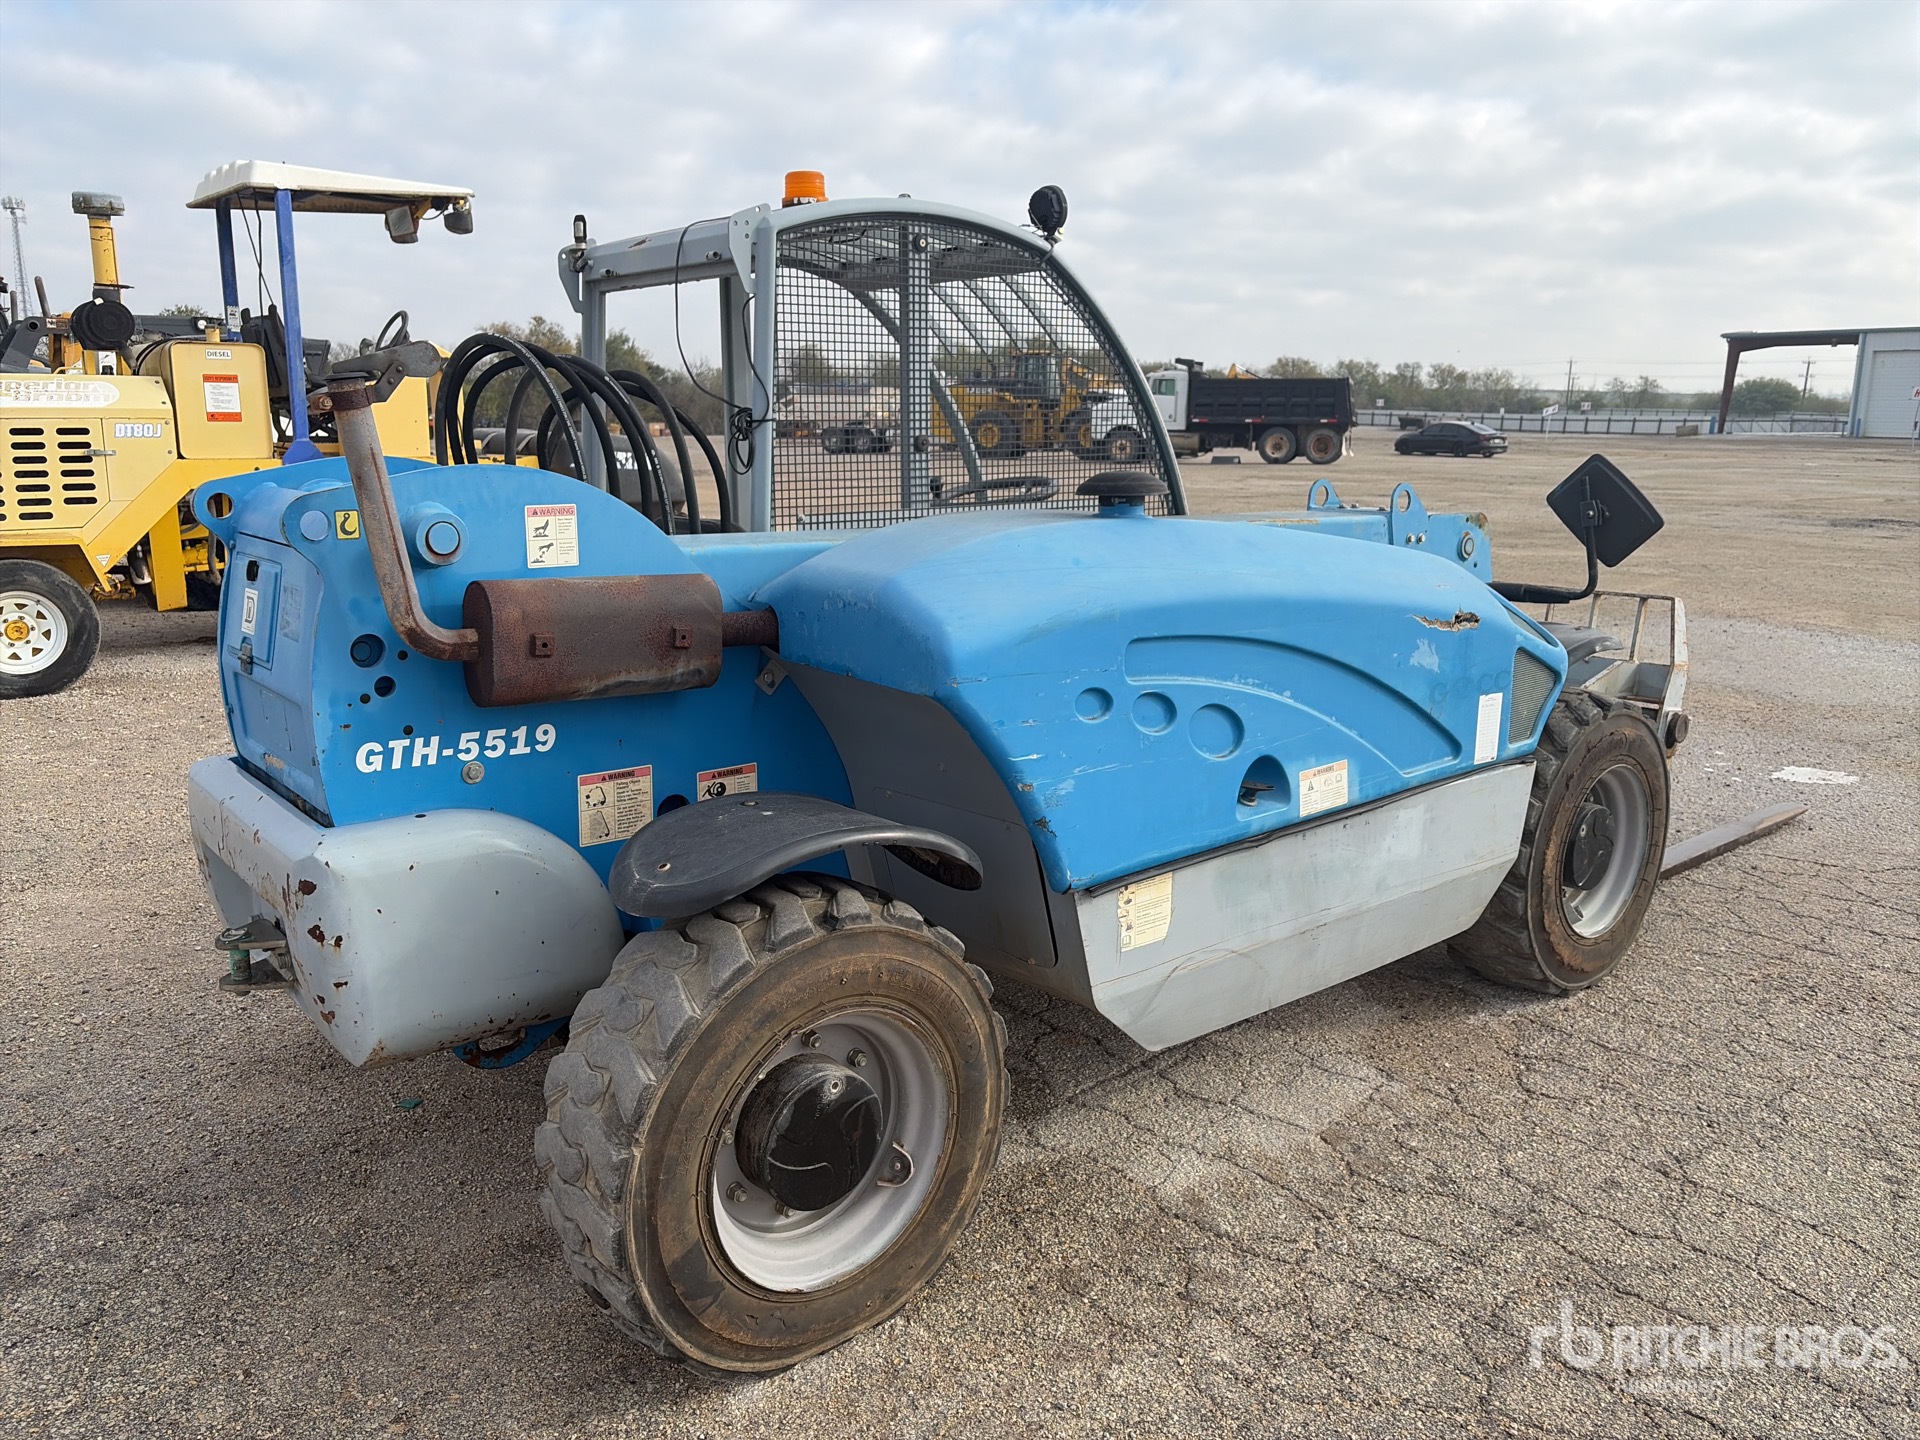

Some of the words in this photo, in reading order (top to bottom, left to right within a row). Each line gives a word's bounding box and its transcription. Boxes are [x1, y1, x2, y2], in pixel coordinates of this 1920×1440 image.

[206, 350, 231, 358] DIESEL
[114, 423, 162, 438] DT80J
[539, 507, 574, 516] WARNING
[354, 723, 556, 774] GTH-5519
[608, 770, 636, 780] WARNING
[717, 767, 744, 778] WARNING
